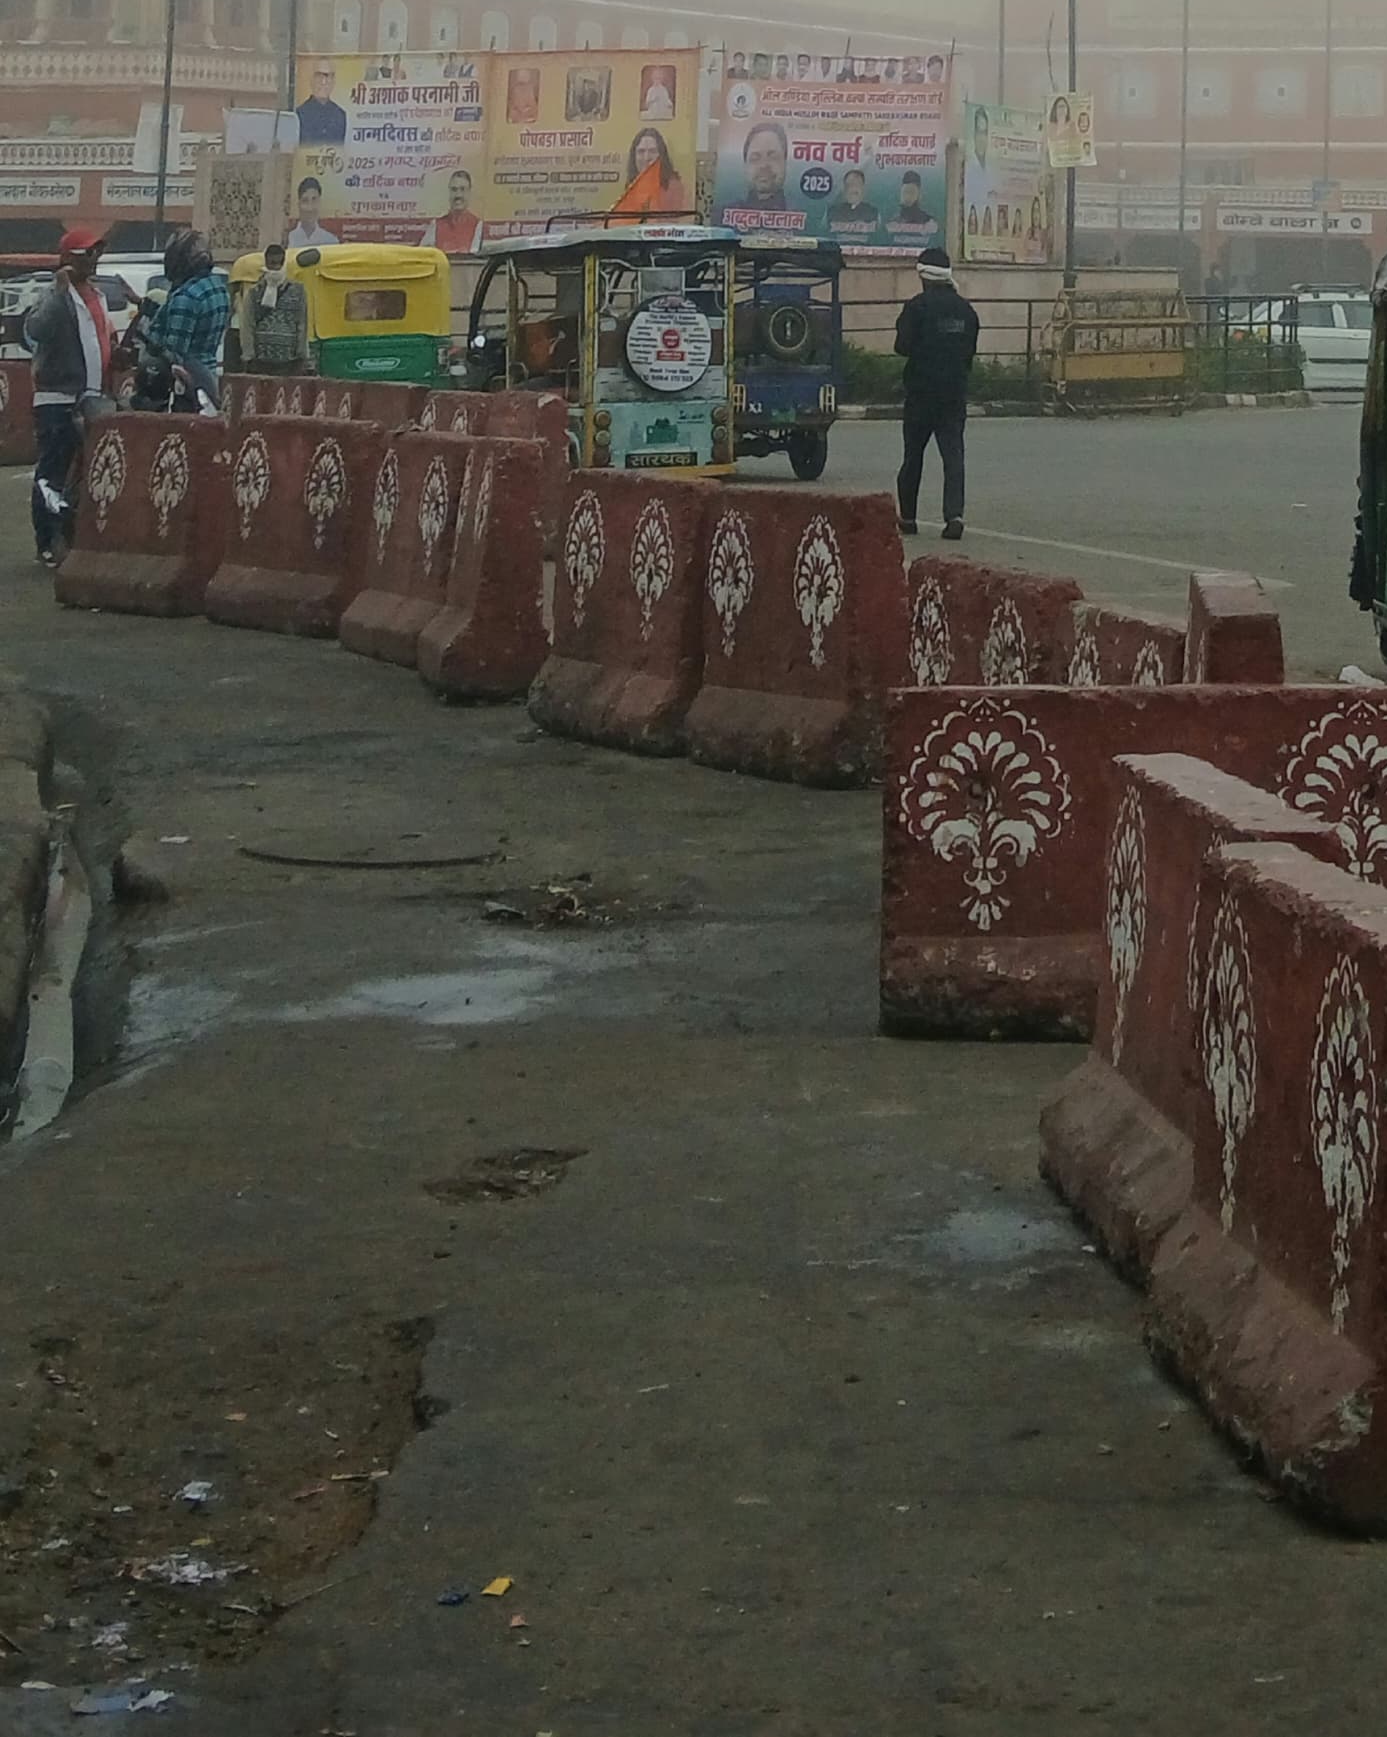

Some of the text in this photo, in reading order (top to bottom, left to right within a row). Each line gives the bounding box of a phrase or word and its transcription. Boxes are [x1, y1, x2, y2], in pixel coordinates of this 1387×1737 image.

[369, 81, 408, 104] अशोक
[412, 81, 459, 104] परनामी
[461, 80, 480, 104] जी
[353, 123, 418, 143] जन्मदिवस
[792, 135, 864, 164] नव वर्ष
[803, 176, 831, 192] 2025
[723, 209, 806, 230] अब्दुल सलाम
